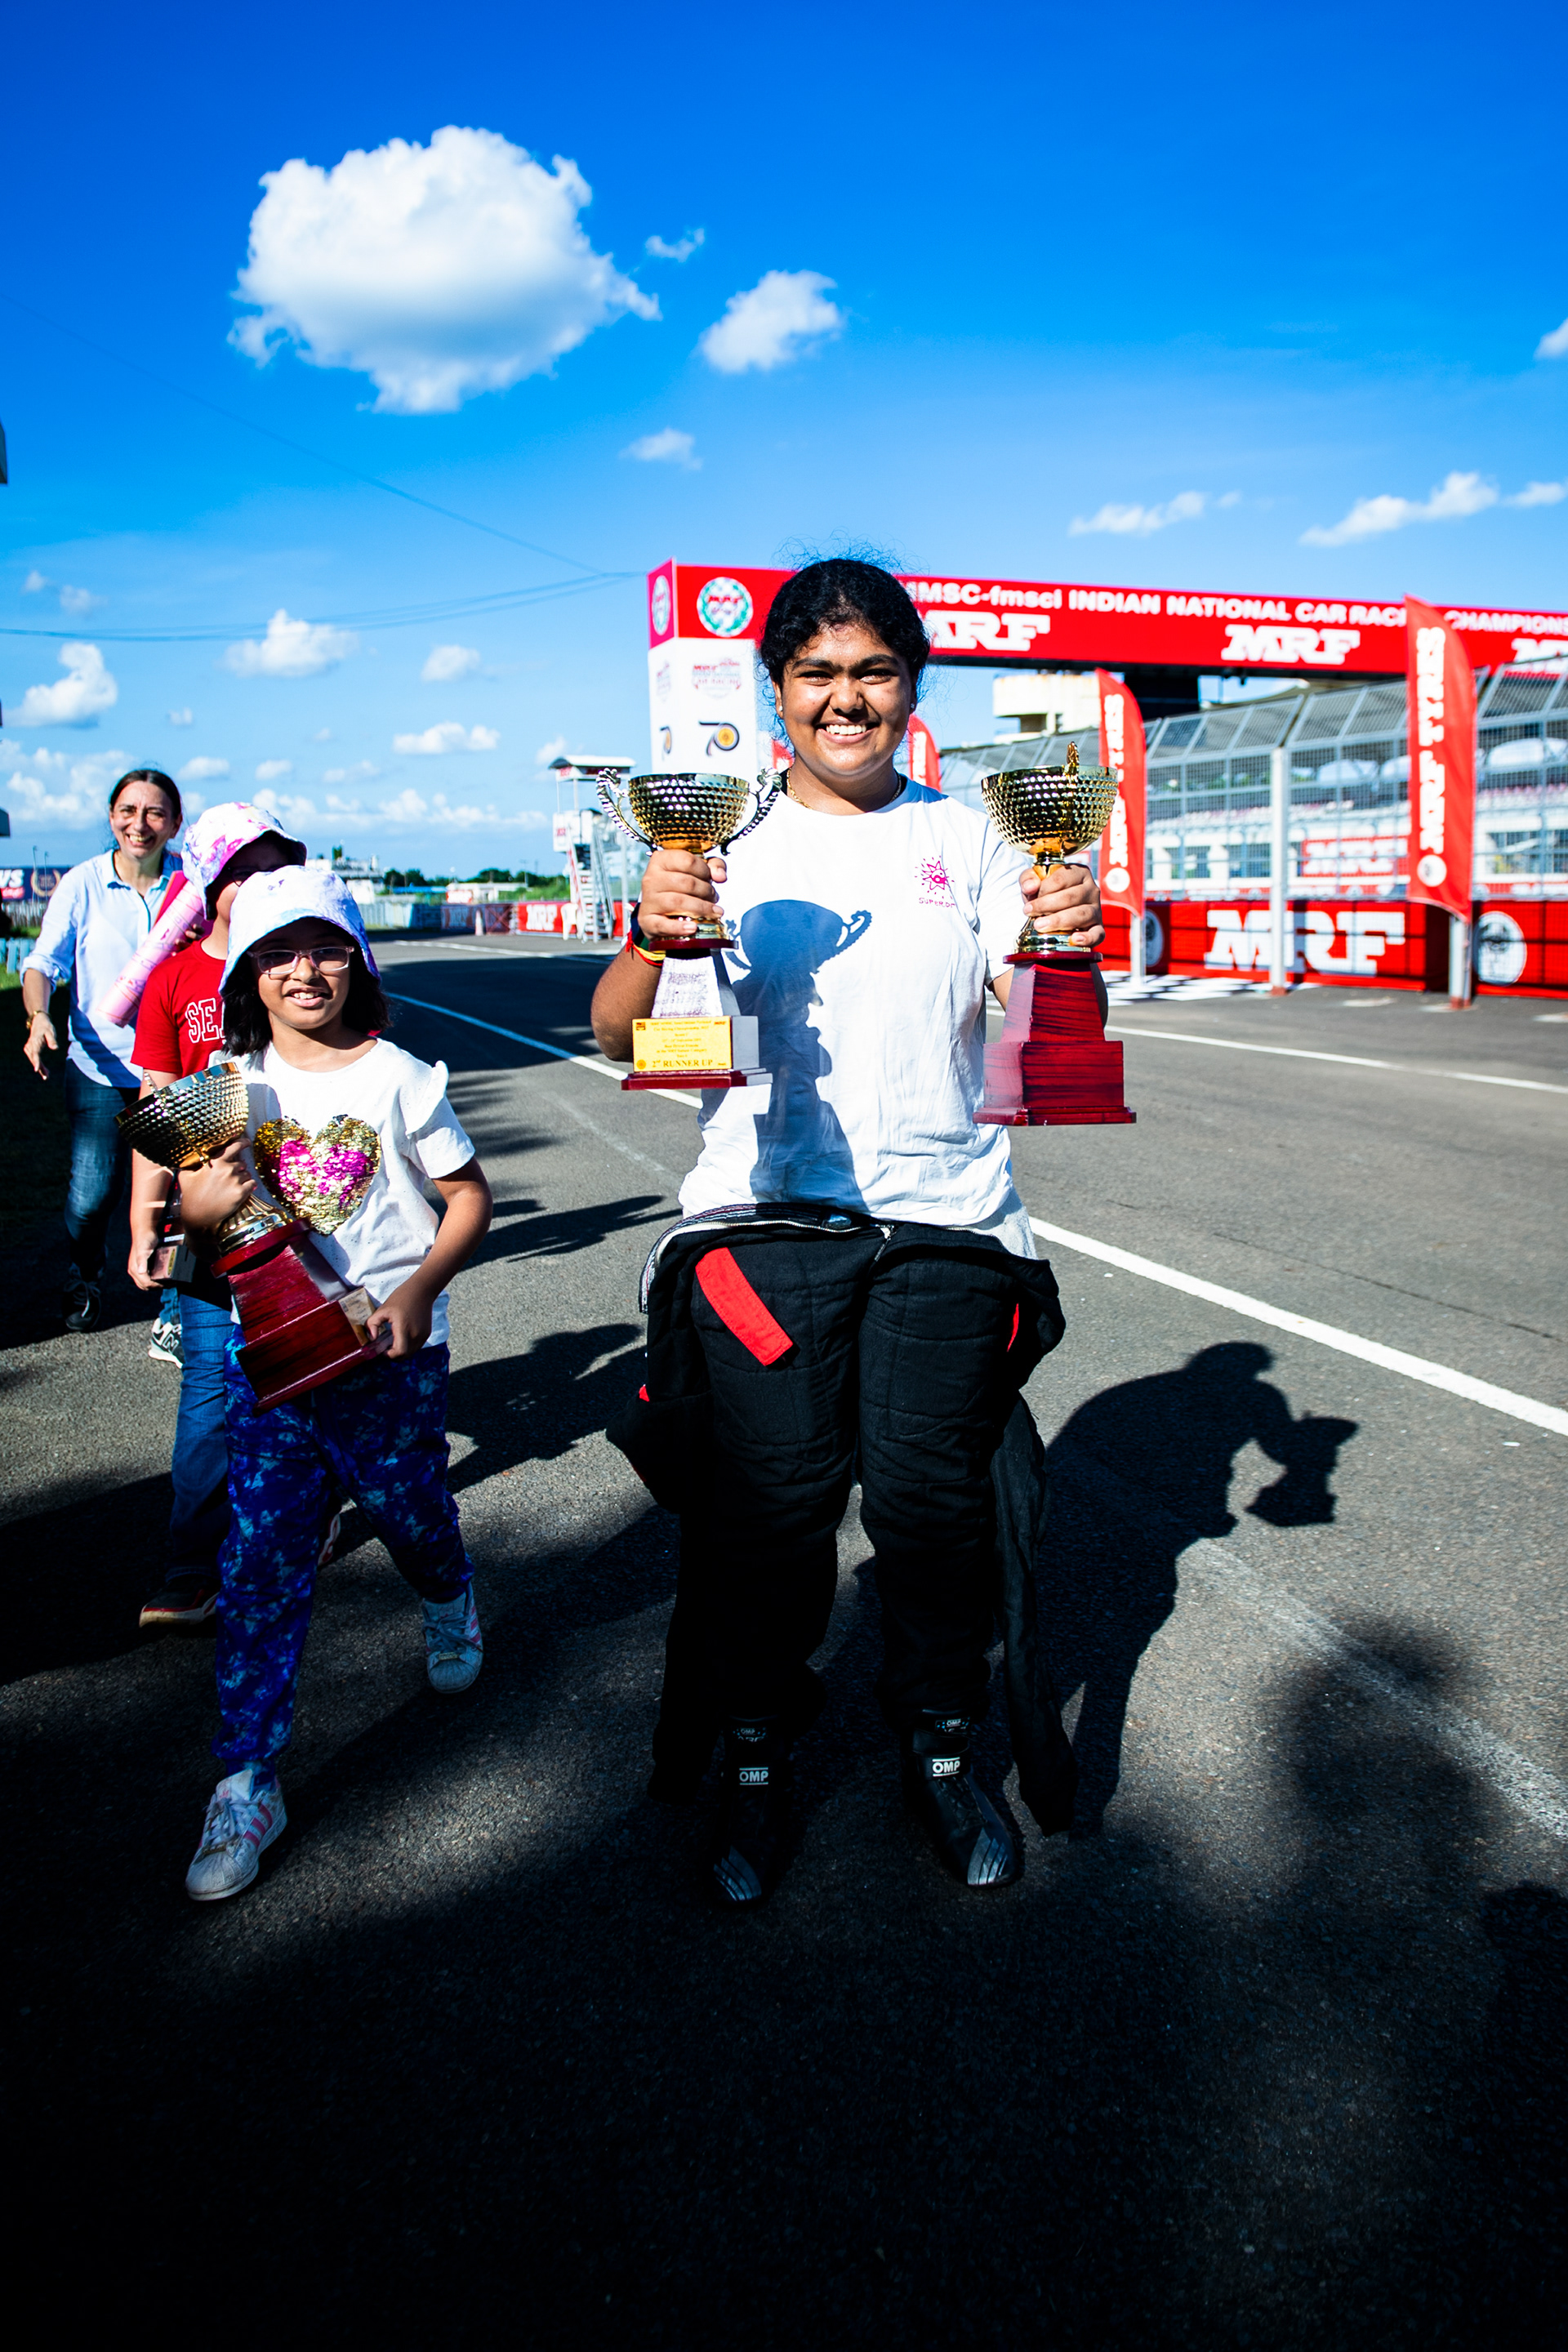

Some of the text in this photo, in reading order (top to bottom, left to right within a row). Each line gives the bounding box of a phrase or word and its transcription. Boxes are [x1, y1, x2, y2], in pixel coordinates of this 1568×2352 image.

[1068, 589, 1161, 615] INDIAN
[1166, 595, 1292, 621] NATIONAL
[1295, 601, 1348, 624] CAR
[1349, 604, 1407, 627] RACI
[1220, 623, 1361, 665] MRF
[1104, 693, 1124, 783] YRES
[1415, 626, 1446, 855] MRF TYRES
[525, 903, 558, 932] MRF
[1205, 909, 1405, 978] MRF
[185, 997, 226, 1045] SE
[663, 1059, 699, 1068] RUNNER
[738, 1771, 769, 1783] OMP
[932, 1760, 961, 1774] OMP
